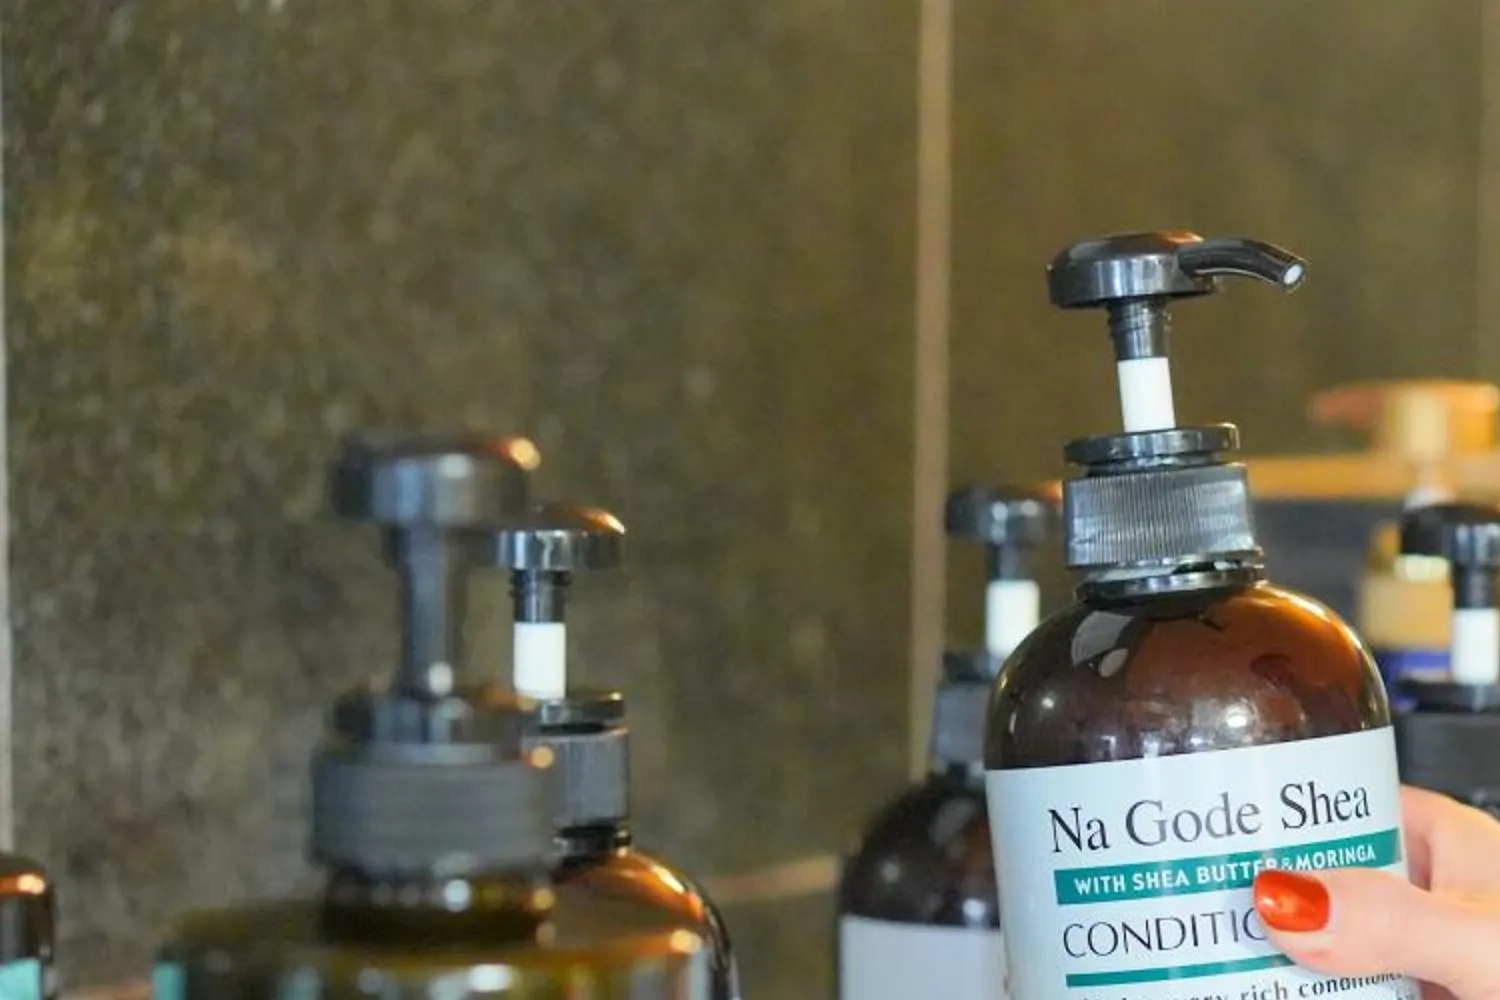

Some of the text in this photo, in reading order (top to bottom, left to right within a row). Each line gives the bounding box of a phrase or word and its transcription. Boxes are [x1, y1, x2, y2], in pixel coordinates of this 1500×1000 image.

[1048, 780, 1372, 853] Na Gode Shea
[1073, 873, 1127, 897] WITH
[1132, 868, 1190, 891] SHEA
[1063, 906, 1269, 958] CONDITIO
